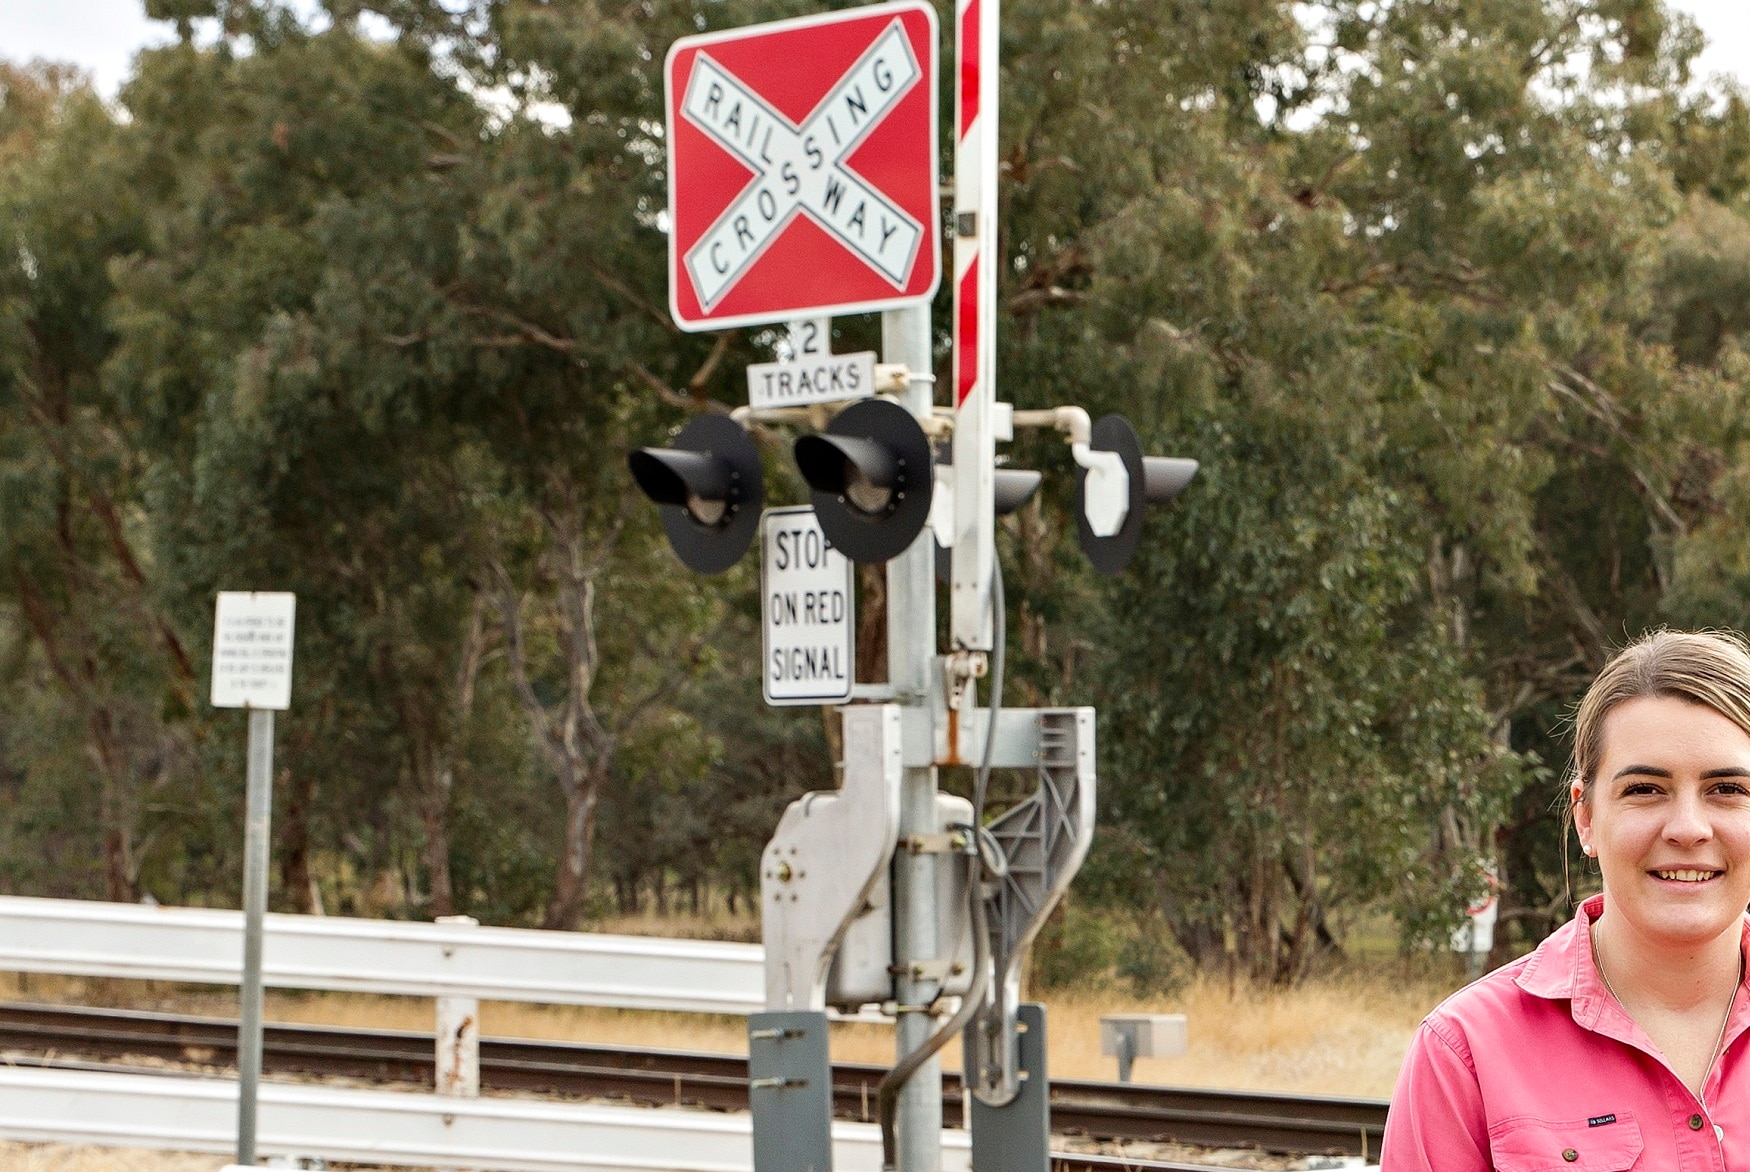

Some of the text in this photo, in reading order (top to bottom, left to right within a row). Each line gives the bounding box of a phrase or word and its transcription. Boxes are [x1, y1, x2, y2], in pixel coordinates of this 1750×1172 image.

[710, 58, 893, 275] CROSSING
[802, 320, 818, 354] 2
[762, 362, 861, 398] TRACKS
[771, 590, 845, 626] ON RED
[772, 647, 844, 682] SIGNAL
